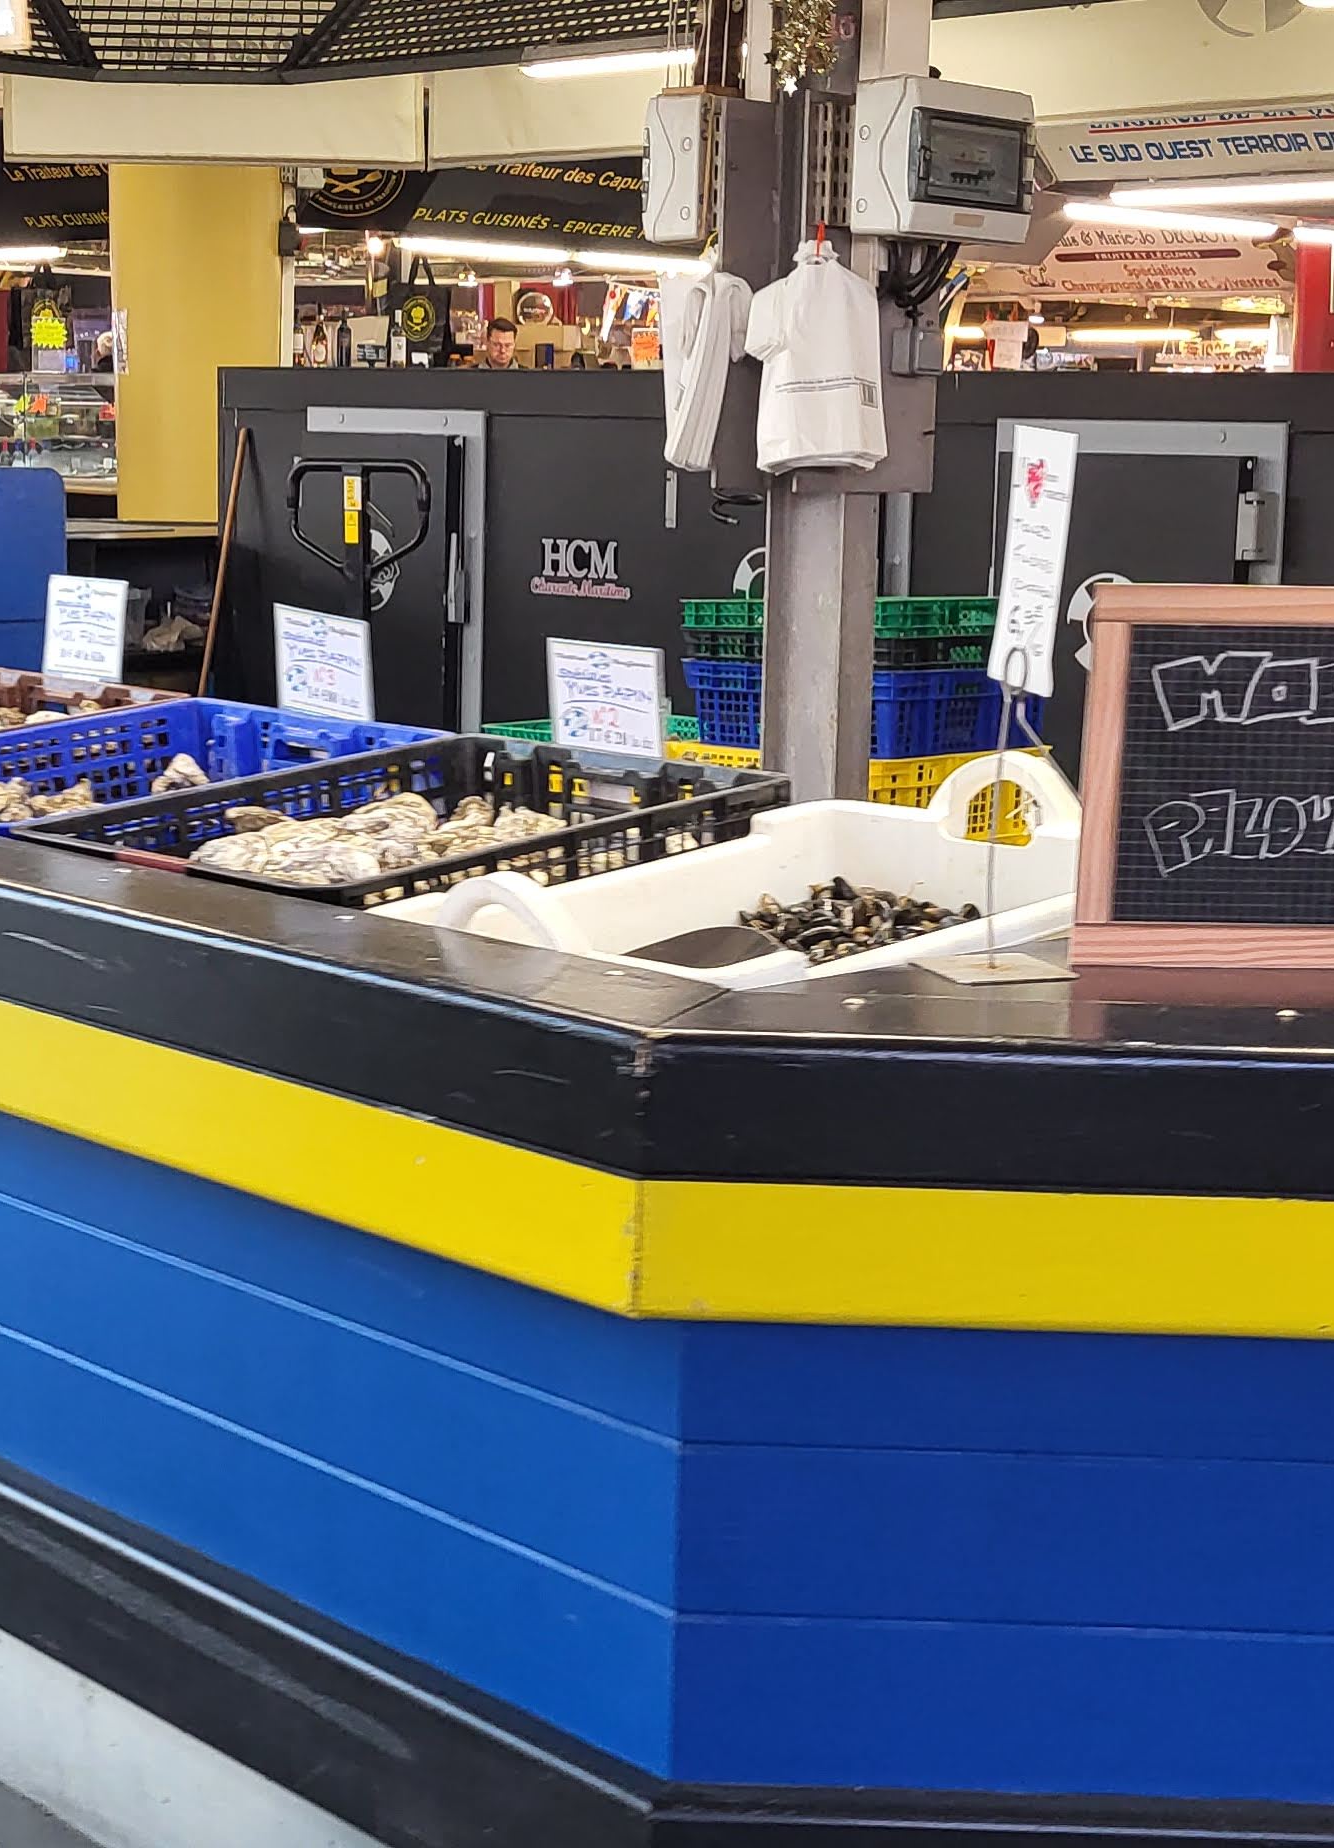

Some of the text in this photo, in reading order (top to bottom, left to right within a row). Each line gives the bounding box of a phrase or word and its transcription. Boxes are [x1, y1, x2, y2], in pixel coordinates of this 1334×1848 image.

[1069, 145, 1097, 163] LE
[1098, 143, 1142, 162] SUD
[1145, 139, 1213, 160] OUEST
[1217, 132, 1313, 157] TERROIR
[3, 164, 101, 181] Le Traiteur des
[563, 167, 596, 184] des
[598, 171, 643, 191] Capu
[24, 214, 63, 228] PLATS
[412, 207, 469, 224] PLATS
[472, 211, 551, 230] CUISINÉS
[563, 220, 637, 239] EPICERIE
[1095, 252, 1132, 260] FRUITS
[1133, 252, 1147, 260] ET
[1062, 279, 1144, 293] Champignons
[1145, 278, 1161, 290] de
[1162, 277, 1196, 290] Paris
[1198, 278, 1208, 289] et
[542, 538, 618, 579] HCM
